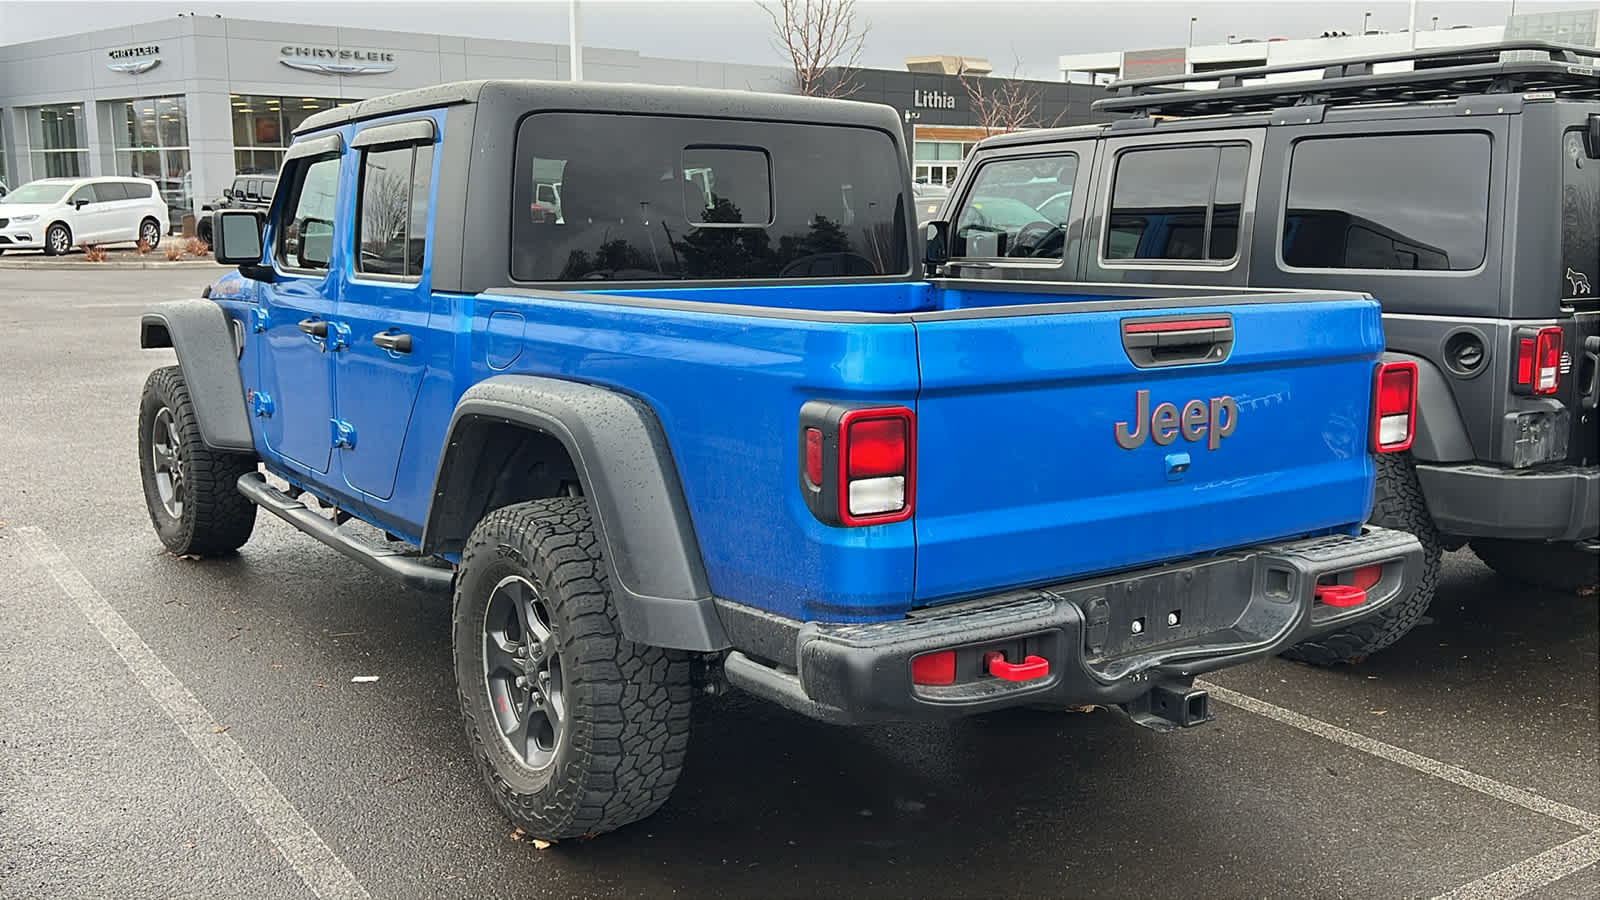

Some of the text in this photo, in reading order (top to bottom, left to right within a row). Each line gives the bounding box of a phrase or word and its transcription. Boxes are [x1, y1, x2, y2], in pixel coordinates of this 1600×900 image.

[281, 46, 394, 61] CHRYSLER
[914, 89, 955, 109] Lithia
[1114, 389, 1238, 450] Jeep
